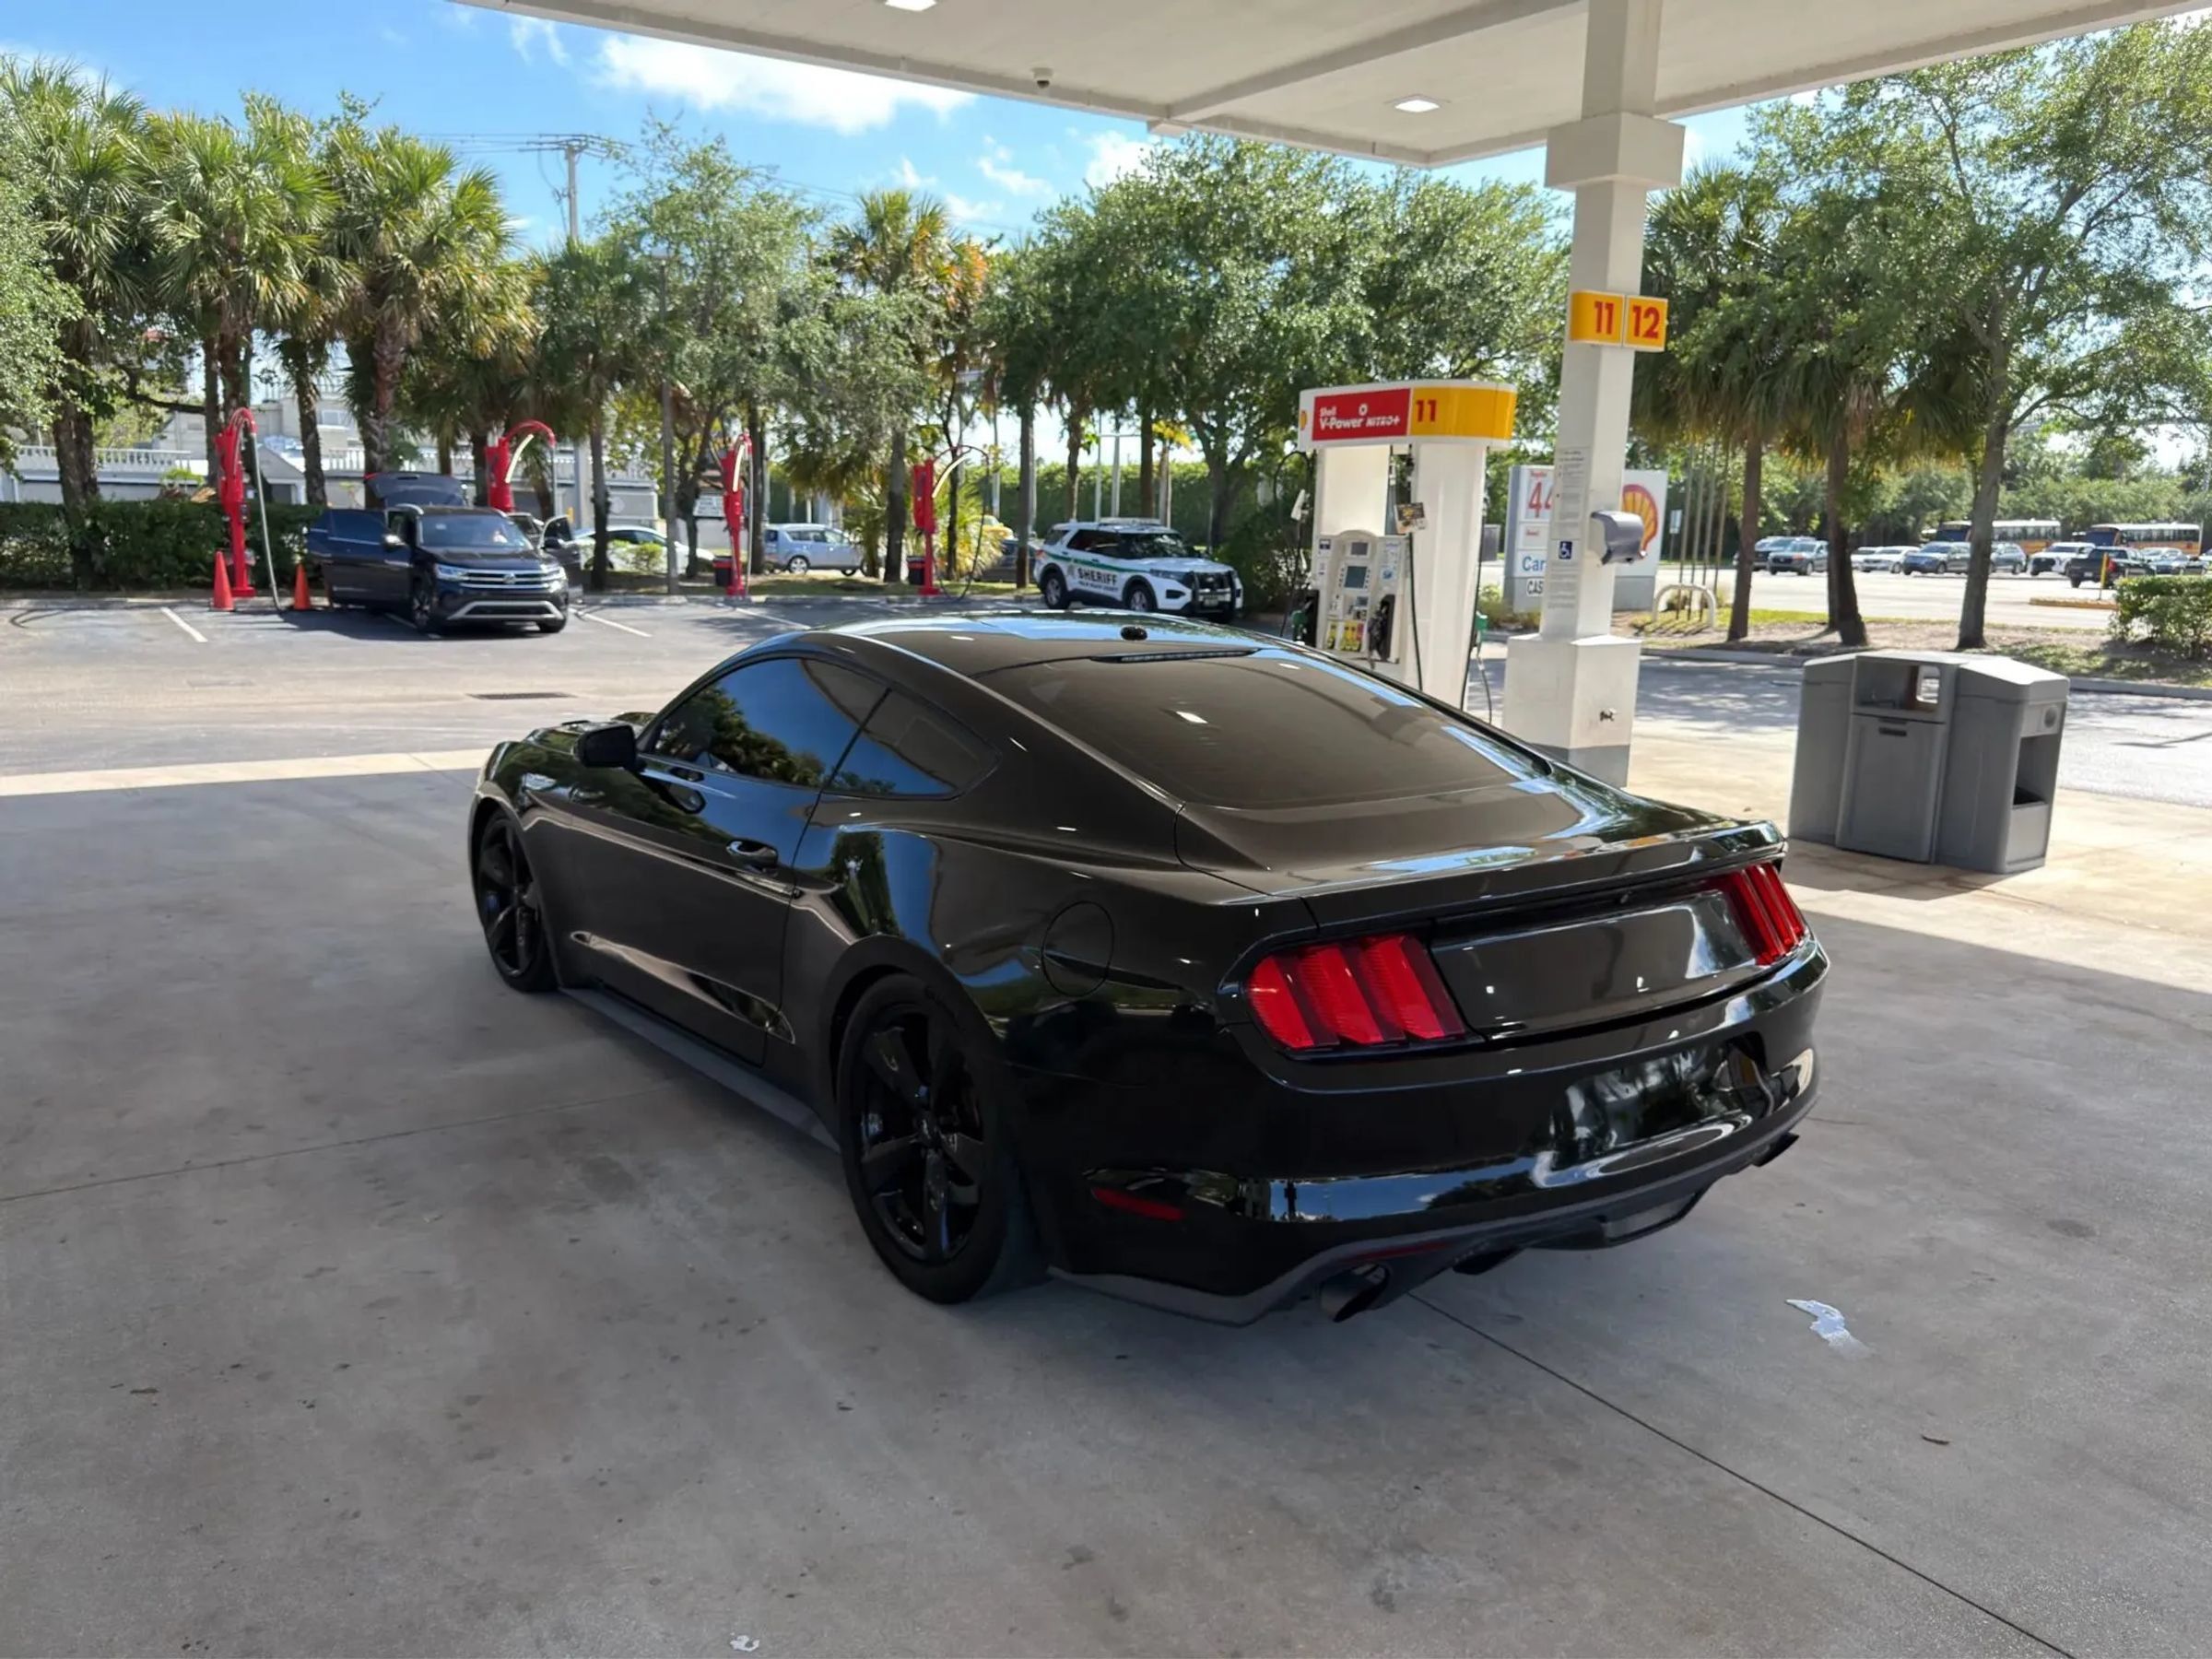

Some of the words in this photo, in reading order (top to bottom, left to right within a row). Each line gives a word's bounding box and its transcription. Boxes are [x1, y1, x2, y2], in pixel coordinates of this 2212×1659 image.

[1594, 301, 1615, 335] 11
[1632, 305, 1660, 339] 12
[1416, 399, 1437, 422] 11
[1320, 417, 1362, 430] V-Power
[1522, 556, 1546, 571] Car
[1077, 568, 1118, 585] SHERIFF
